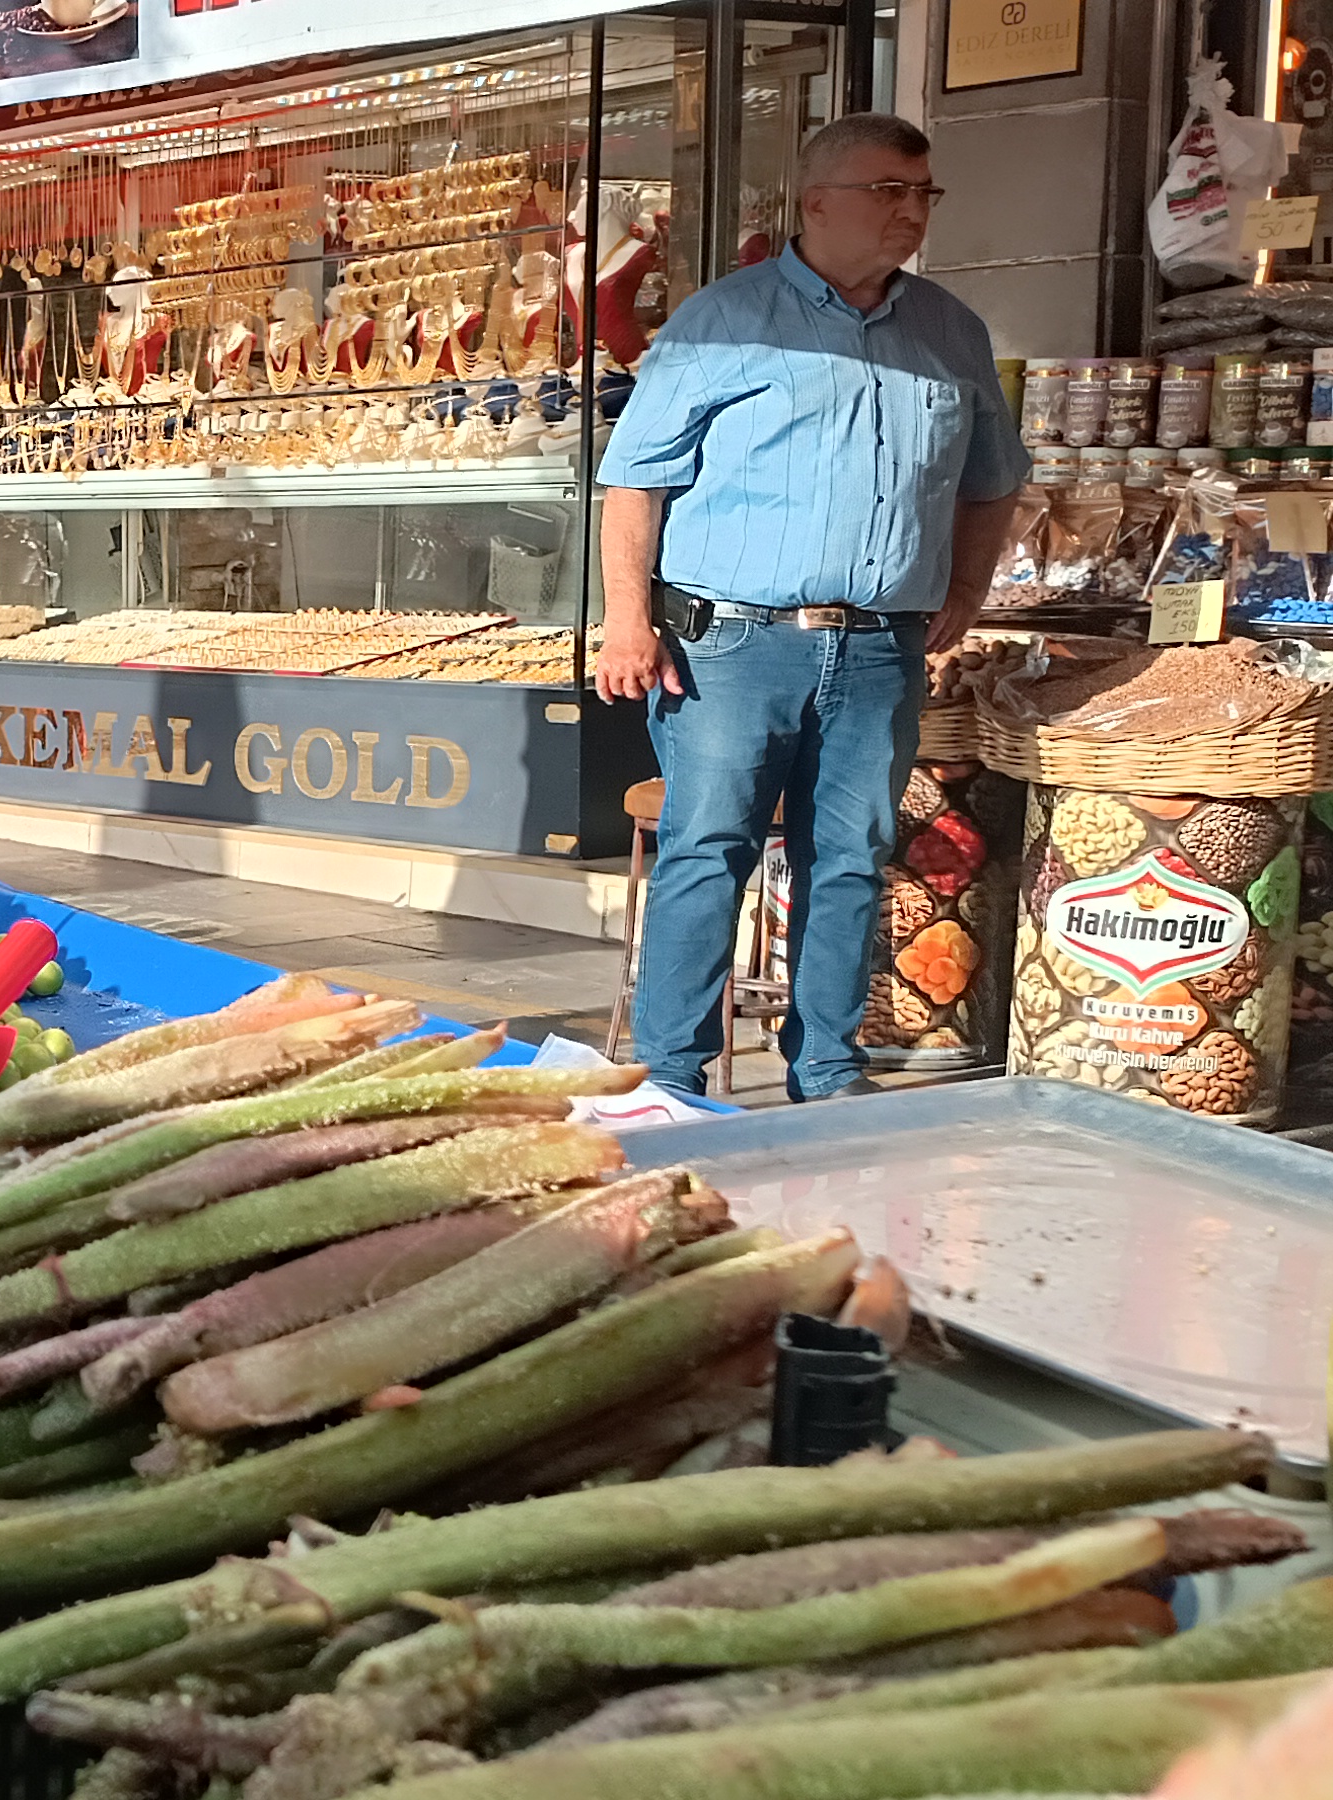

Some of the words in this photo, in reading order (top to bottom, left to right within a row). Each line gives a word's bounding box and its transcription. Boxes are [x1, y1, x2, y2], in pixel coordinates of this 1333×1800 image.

[234, 721, 471, 810] GOLD
[1065, 905, 1227, 950] Hakimoğlu
[1089, 1022, 1129, 1042] Kuru
[1130, 1026, 1184, 1047] Kahve
